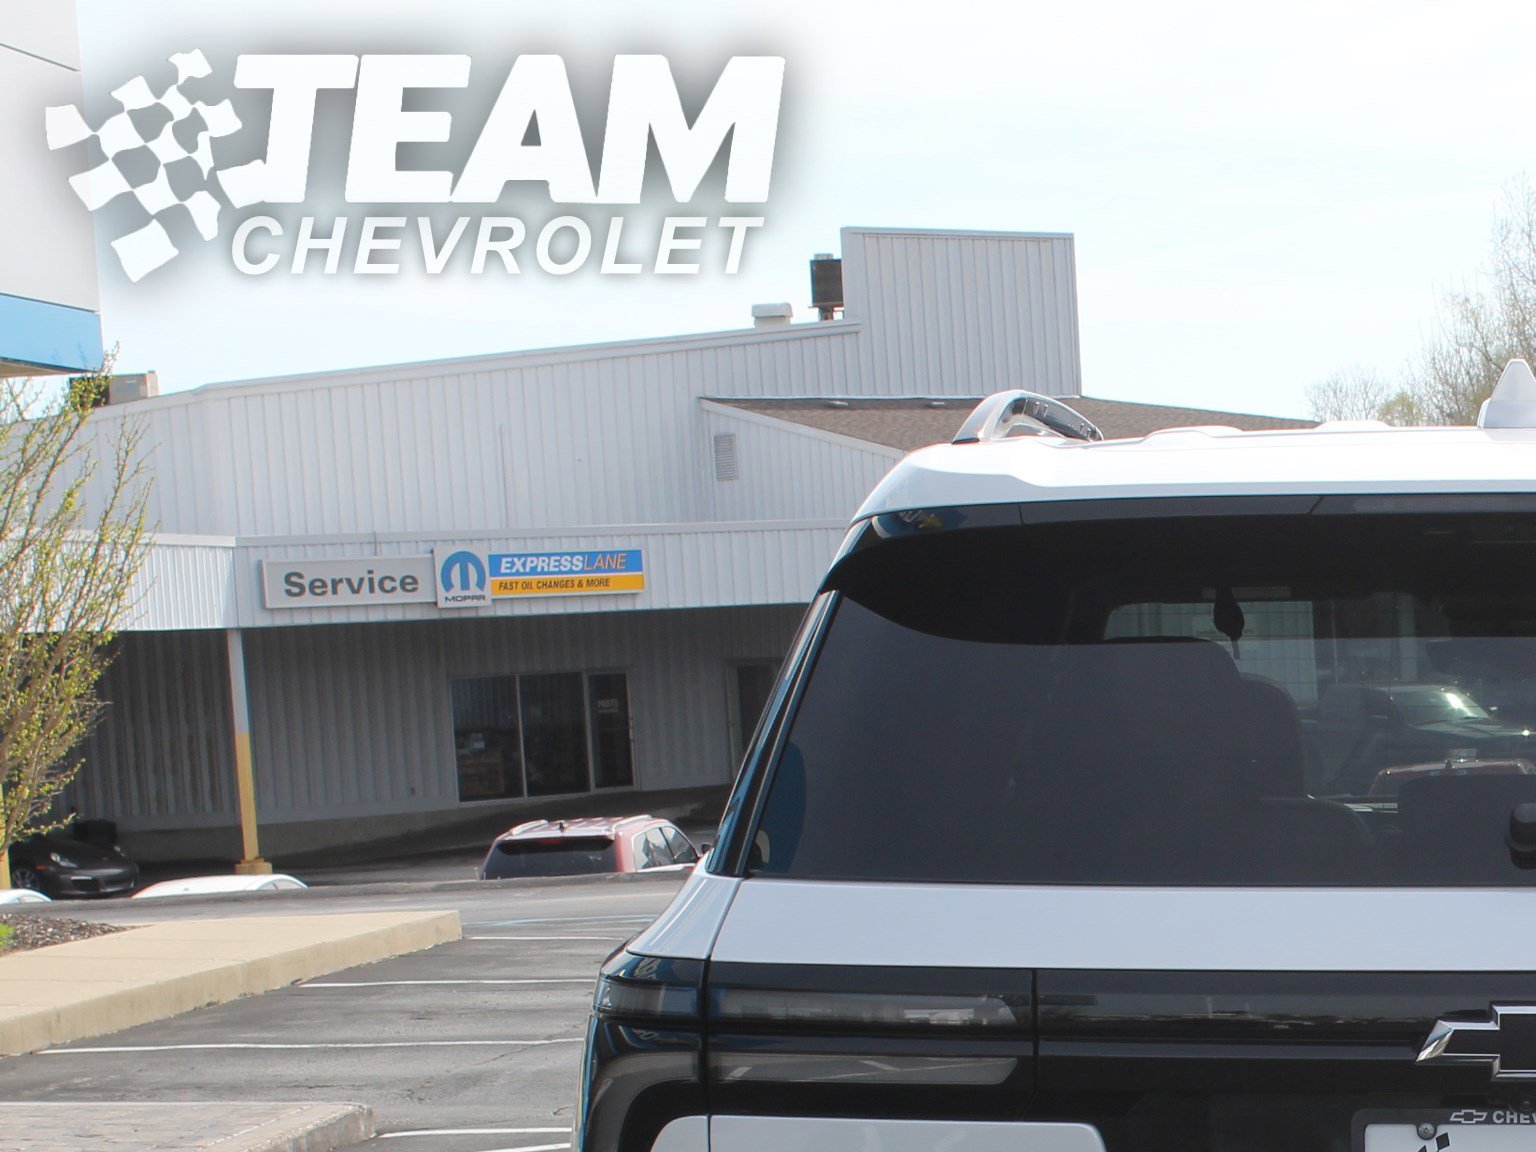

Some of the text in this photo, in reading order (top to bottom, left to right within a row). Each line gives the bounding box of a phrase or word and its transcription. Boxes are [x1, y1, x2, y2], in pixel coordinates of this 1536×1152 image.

[284, 570, 419, 598] Service
[499, 578, 610, 591] FAST OIL CHANGES & MORE
[445, 595, 486, 603] MOPAR
